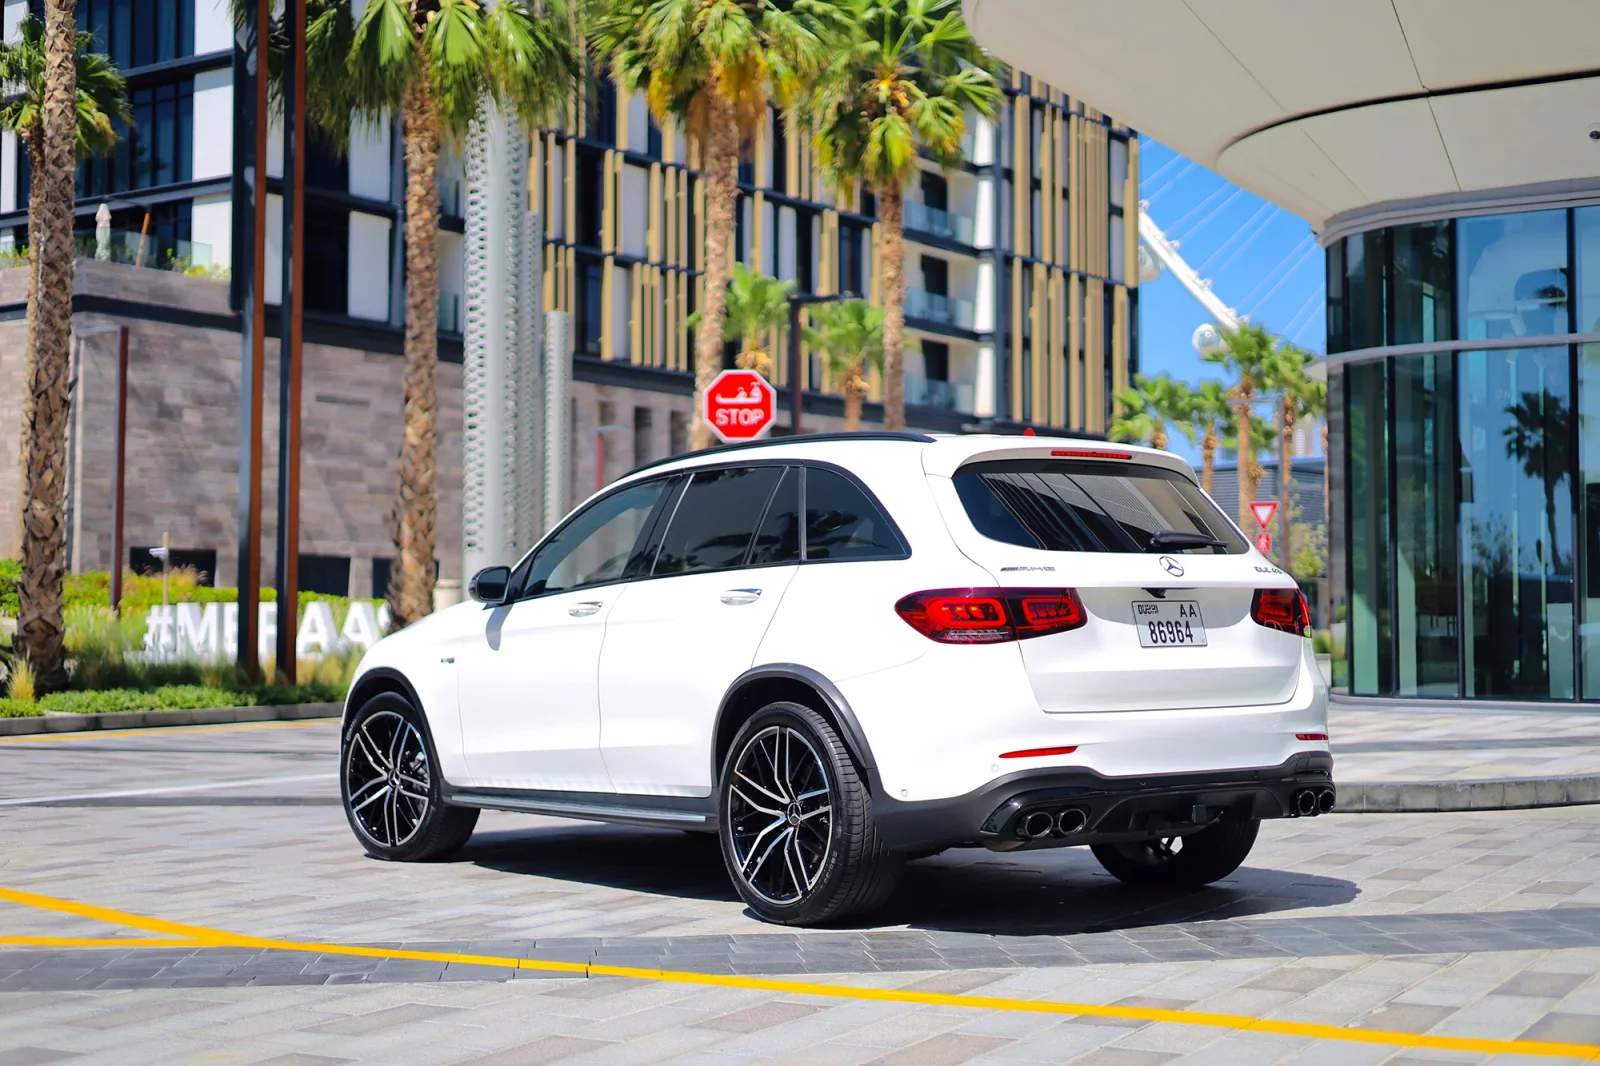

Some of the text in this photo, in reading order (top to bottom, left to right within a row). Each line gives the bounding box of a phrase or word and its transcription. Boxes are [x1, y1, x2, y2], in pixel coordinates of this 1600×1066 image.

[715, 381, 763, 404] قف
[715, 408, 765, 426] STOP
[1180, 604, 1198, 618] AA
[1148, 620, 1193, 644] 86964
